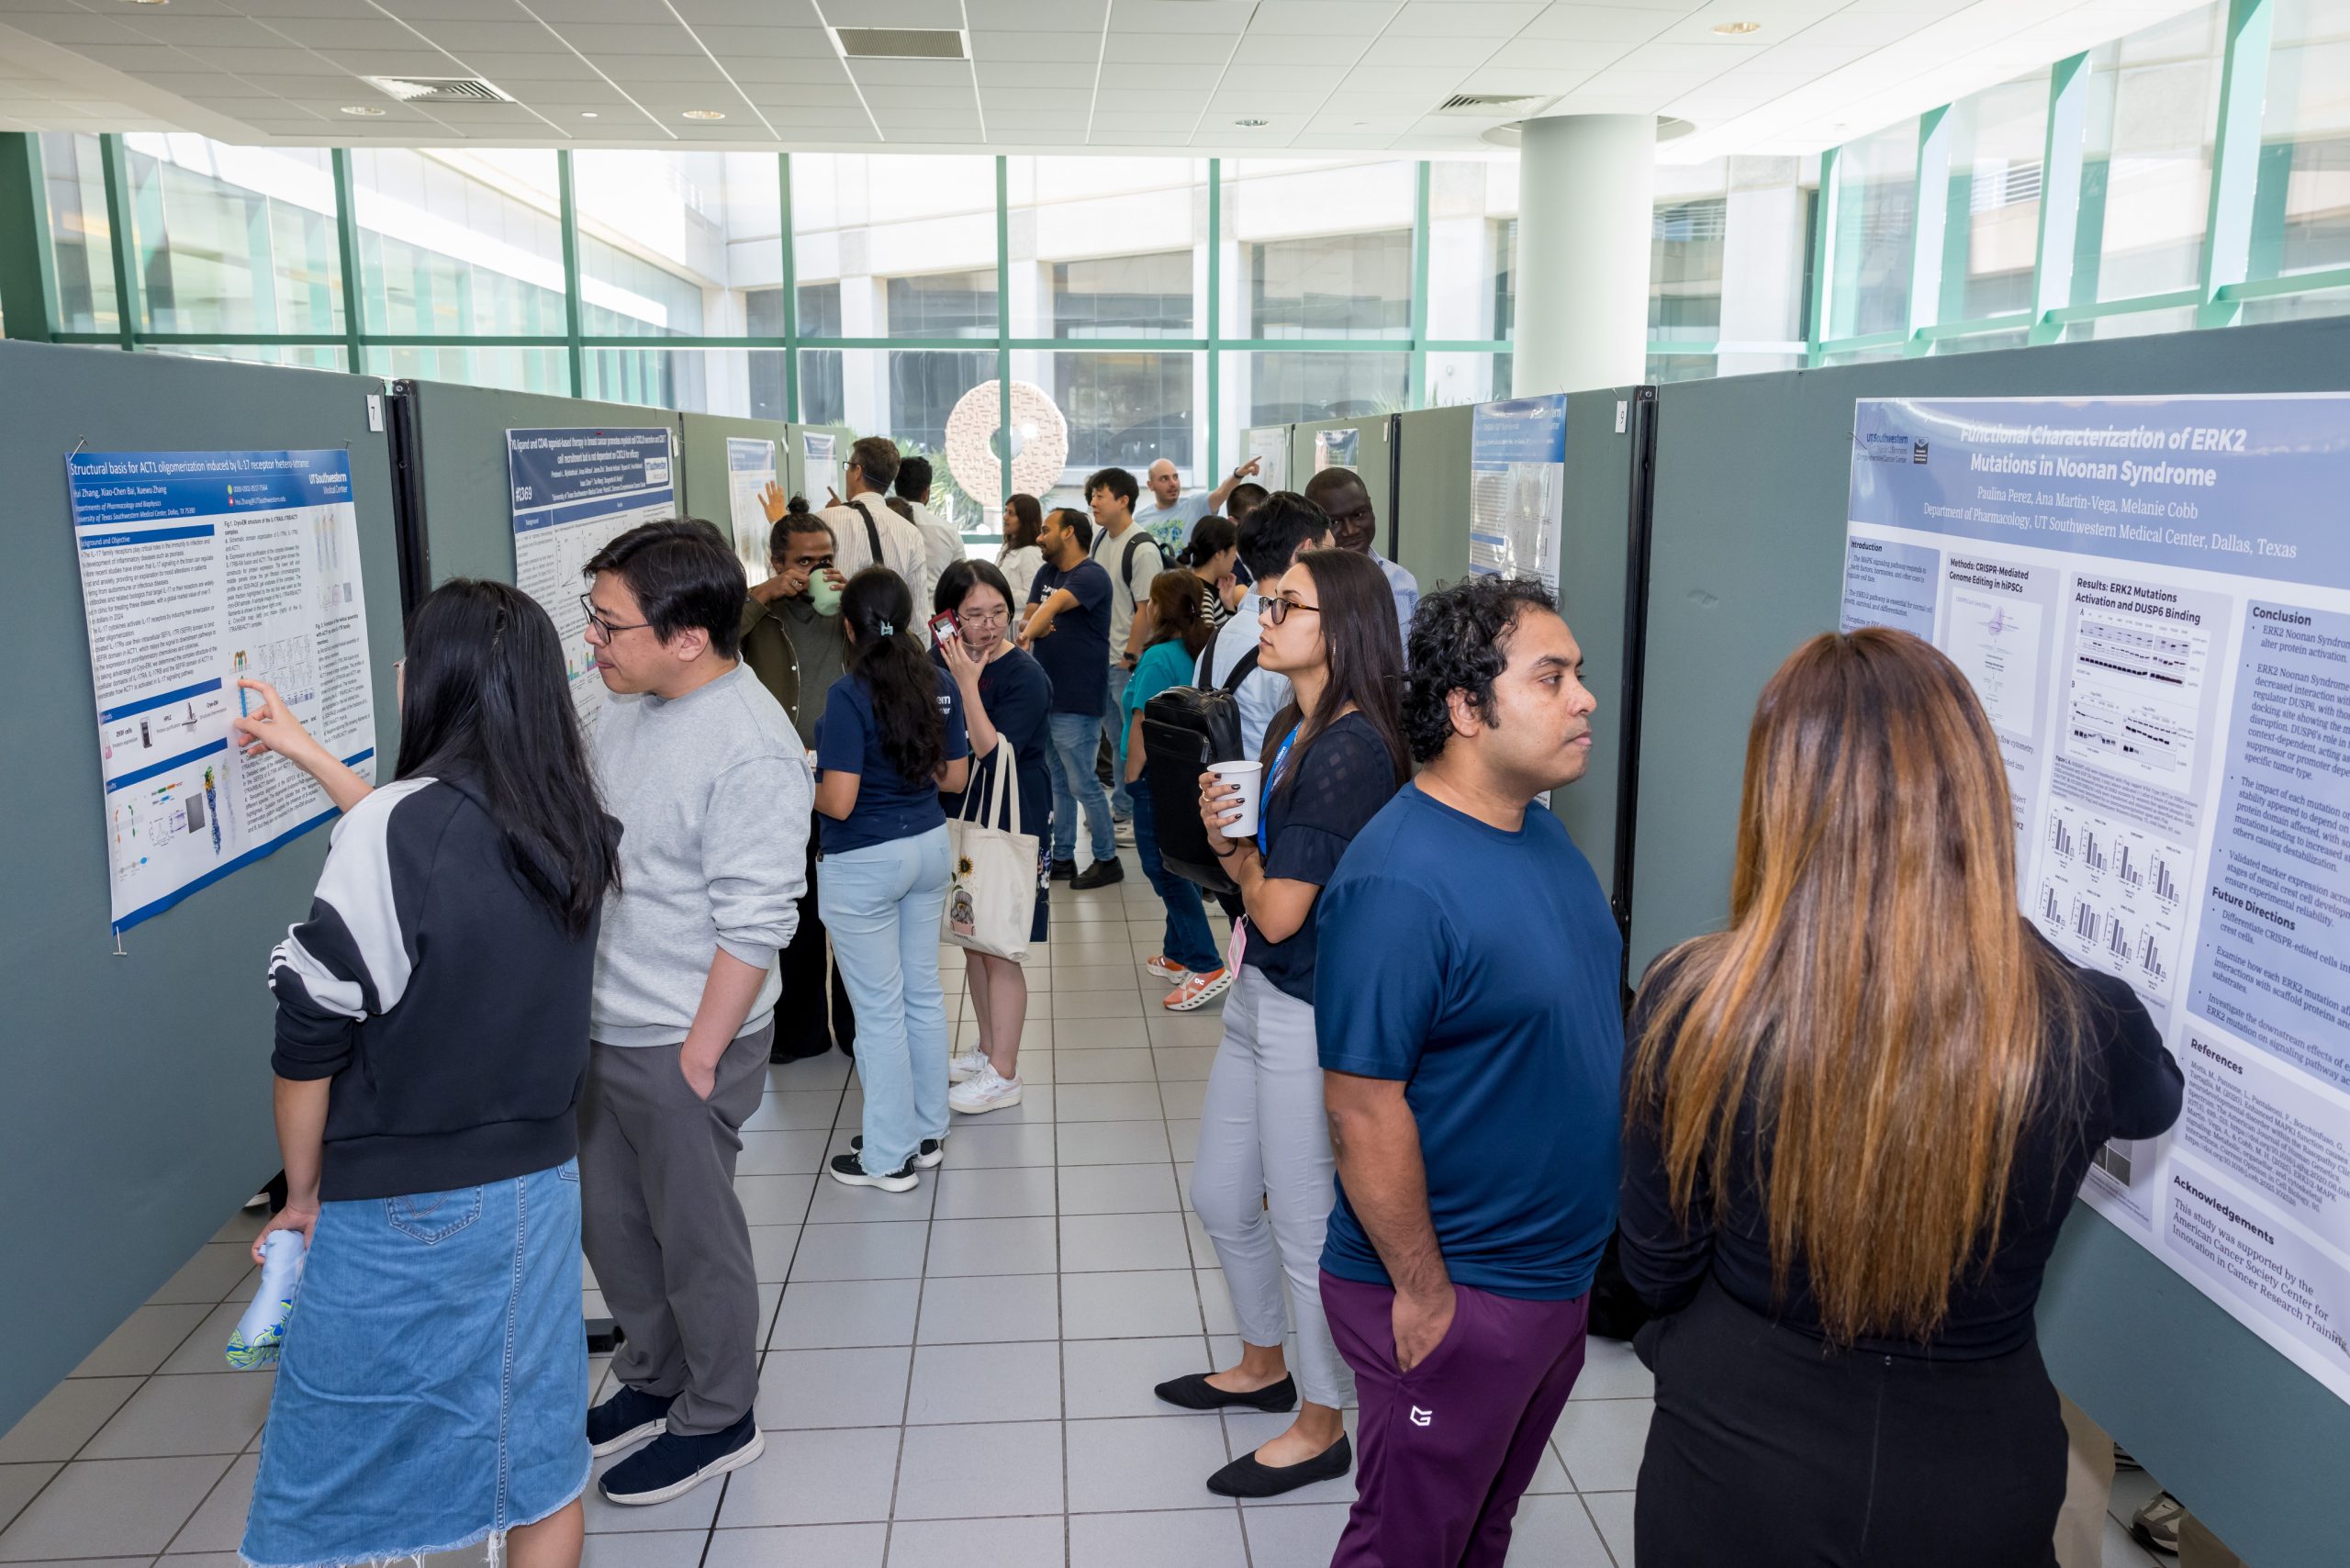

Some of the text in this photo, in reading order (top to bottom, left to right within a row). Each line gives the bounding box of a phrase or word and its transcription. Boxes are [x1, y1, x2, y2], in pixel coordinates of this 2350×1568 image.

[1961, 424, 2246, 453] Functional Characterization of ERK2
[71, 462, 107, 476] Structural
[109, 462, 128, 474] basis
[129, 462, 138, 474] for
[140, 462, 157, 473] ACT1
[158, 461, 206, 475] oligomerization
[206, 460, 229, 470] induced
[229, 460, 236, 472] by
[237, 459, 249, 470] IL-17
[251, 460, 274, 471] receptor
[1971, 454, 2216, 487] Mutations in Noonan Syndrome
[1977, 486, 2198, 519] Paulina Perez, Ana Martin-Vega, Melanie Cobb
[1924, 502, 2297, 558] Department of Pharmacology, UT Southwestern Medical Center, Dallas, Texas
[1851, 541, 1882, 552] Introduction
[1950, 571, 1972, 583] Genome
[1973, 576, 1993, 589] Editing
[1994, 579, 2000, 588] in
[1951, 558, 2029, 579] Methods: CRISPR-Mediated
[2077, 577, 2177, 602] Results: ERK2 Mutations
[2076, 593, 2115, 608] Activation
[2118, 601, 2133, 610] and
[2134, 602, 2164, 616] DUSP6
[2165, 608, 2200, 625] Binding
[2253, 607, 2311, 626] Conclusion
[2263, 625, 2315, 643] ERK2 Noonan
[2261, 638, 2347, 663] alter protein activation.
[2255, 676, 2334, 702] decreased interaction
[2257, 664, 2350, 691] ERK2 Noonan Syndrome
[2252, 701, 2342, 732] docking site showing the
[2254, 690, 2288, 704] regulator
[2319, 705, 2334, 716] with
[2250, 714, 2288, 732] disruption.
[2322, 734, 2337, 745] role
[2338, 737, 2346, 747] in
[2244, 754, 2312, 779] specific tumor type.
[2246, 741, 2331, 771] suppressor or promoter
[2318, 748, 2341, 762] acting
[2242, 777, 2340, 817] The impact of each mutation
[2212, 887, 2295, 930] Future Directions
[2221, 924, 2255, 945] crest cells.
[2222, 910, 2338, 968] Differentiate CRISPR-edited cells
[2207, 1005, 2339, 1081] ERK2 mutation on signaling pathway
[2209, 992, 2344, 1068] Investigate the downstream effects of
[2191, 1038, 2243, 1074] References
[2174, 1176, 2274, 1245] Acknowledgements
[2175, 1198, 2313, 1295] This study was supported by the
[2174, 1212, 2328, 1321] American Cancer Society Center for
[2174, 1224, 2215, 1261] Innovation
[2217, 1255, 2225, 1268] in
[2228, 1263, 2258, 1289] Cancer
[2260, 1284, 2302, 1320] Research
